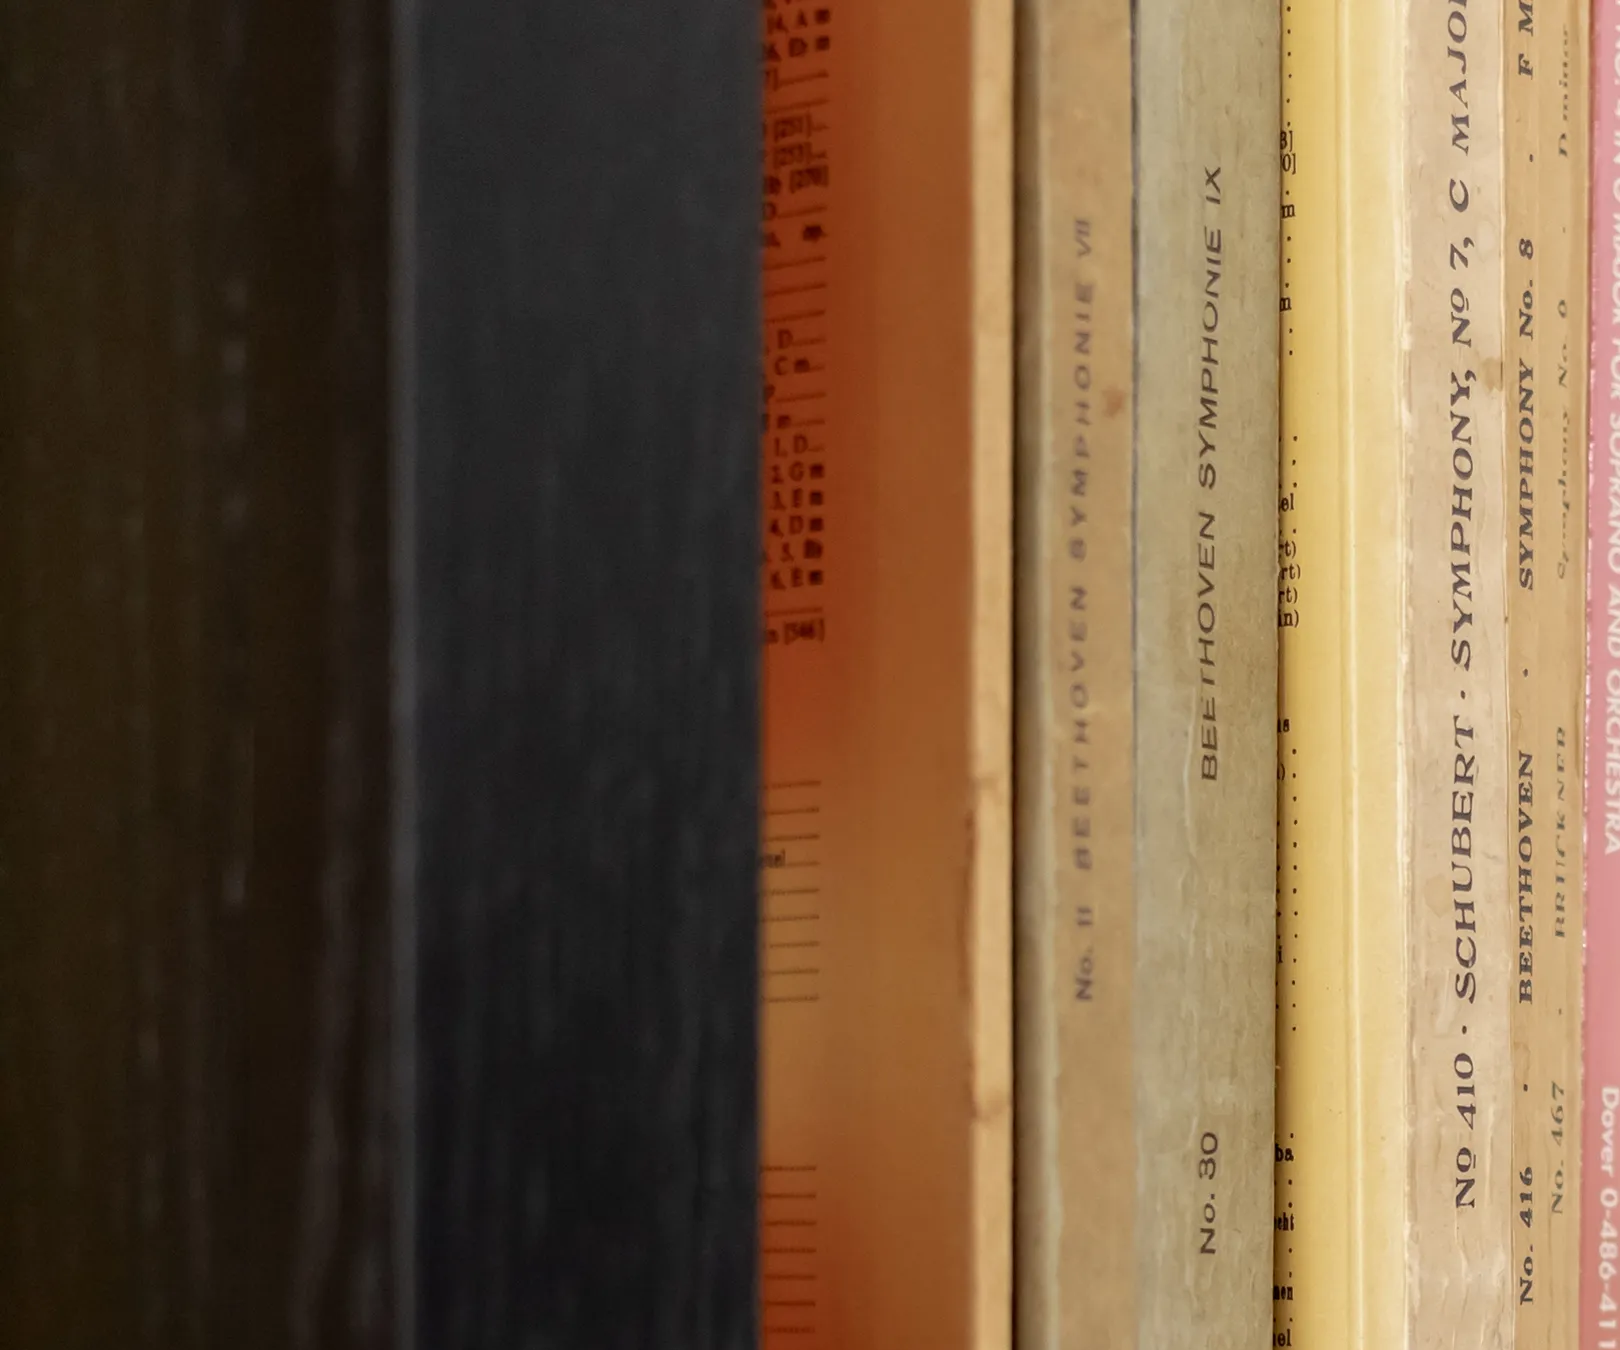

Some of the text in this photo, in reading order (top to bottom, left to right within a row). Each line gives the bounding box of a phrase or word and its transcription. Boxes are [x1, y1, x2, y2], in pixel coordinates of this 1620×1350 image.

[1518, 54, 1534, 80] F
[1449, 179, 1469, 212] C
[1449, 237, 1475, 270] 7,
[1518, 239, 1533, 260] 8
[1518, 279, 1533, 340] No.
[1068, 283, 1093, 562] SYMPHONIE
[1518, 358, 1535, 590] SYMPHONY
[1450, 370, 1478, 670] SYMPHONY,
[1067, 587, 1093, 871] BEETHOVEN
[1198, 166, 1223, 1255] No. 30 BEETHOVEN SYMPHONIE IX
[1451, 715, 1478, 1004] SCHUBERT
[1518, 750, 1535, 1004] BEETHOVEN
[1454, 1053, 1476, 1130] 410
[1550, 1081, 1565, 1145] 467
[1518, 1167, 1535, 1228] 416
[1518, 1244, 1535, 1305] No.
